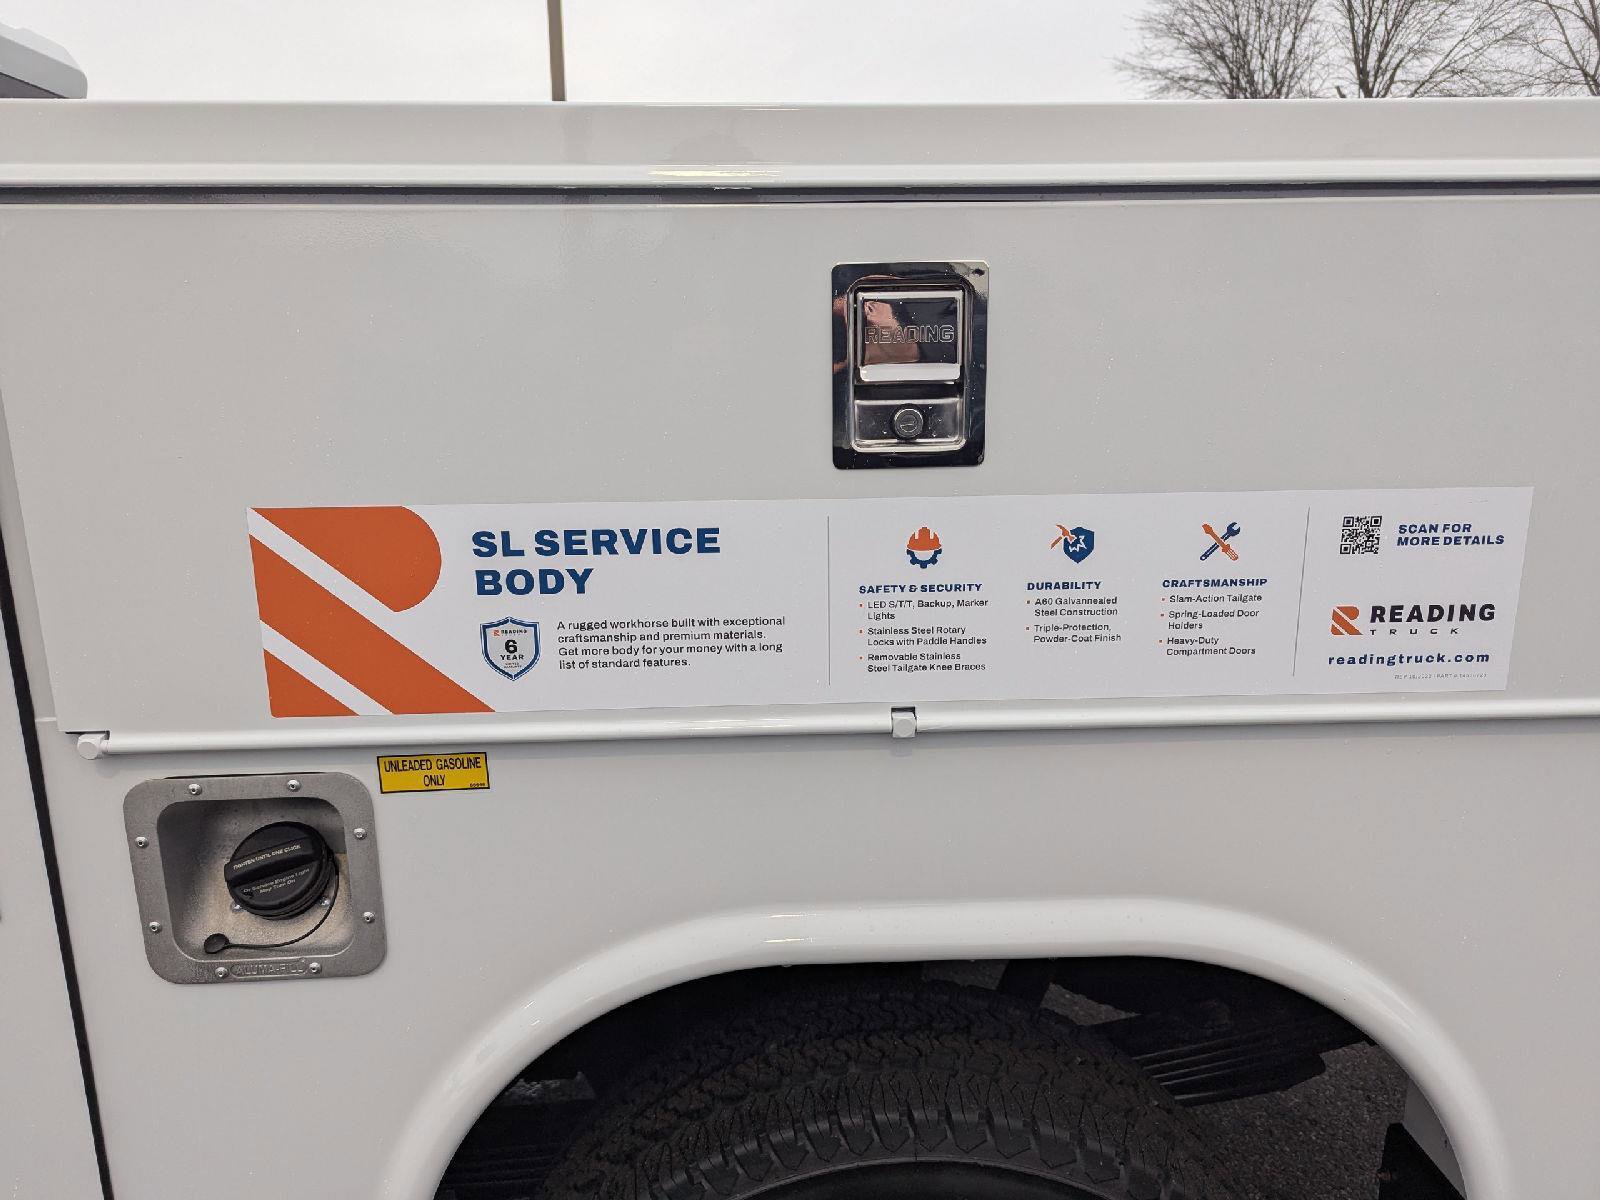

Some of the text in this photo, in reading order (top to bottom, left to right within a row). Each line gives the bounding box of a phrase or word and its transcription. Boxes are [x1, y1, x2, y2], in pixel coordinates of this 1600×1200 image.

[864, 324, 955, 344] READING
[1398, 523, 1472, 535] SCAN FOR
[472, 527, 720, 559] SL SERVICE
[1397, 535, 1504, 546] MORE DETAILS
[475, 568, 594, 597] BODY
[1027, 581, 1101, 591] DURABILITY
[1162, 578, 1267, 588] CRAFTSMANSHIP
[859, 585, 906, 594] SAFETY
[920, 584, 982, 592] SECURITY
[868, 599, 988, 610] LED S/T/T, Backup, Marker
[1035, 596, 1117, 606] A60 Galvannealed
[1170, 593, 1262, 605] Slam-Action Tailgate
[868, 612, 895, 621] Lights
[1060, 608, 1118, 616] Construction
[1169, 609, 1259, 620] Spring-Loaded Door
[1370, 604, 1495, 623] READING
[557, 616, 785, 631] A rugged workhorse built with exceptional
[1034, 623, 1111, 633] Triple-Protection,
[1169, 622, 1203, 631] Holders
[558, 630, 765, 643] craftsmanship and premium materials.
[868, 626, 966, 636] Stainless Steel Rotary
[868, 636, 987, 647] Locks with Paddle Handles
[1034, 634, 1121, 643] Powder-Coat Finish
[1167, 637, 1219, 646] Heavy-Duty
[504, 640, 518, 654] 6
[559, 647, 579, 656] Get
[612, 645, 639, 658] body
[642, 645, 657, 655] for
[658, 646, 684, 655] your
[687, 645, 722, 654] money
[725, 643, 747, 652] with
[759, 643, 782, 653] long
[1167, 647, 1227, 656] Compartment
[560, 657, 690, 669] list of standard features.
[868, 652, 960, 663] Removable Stainless
[1329, 653, 1489, 666] readingtruck.com
[892, 664, 927, 673] Tailgate
[384, 757, 482, 772] UNLEADED GASOLINE
[423, 775, 446, 786] ONLY
